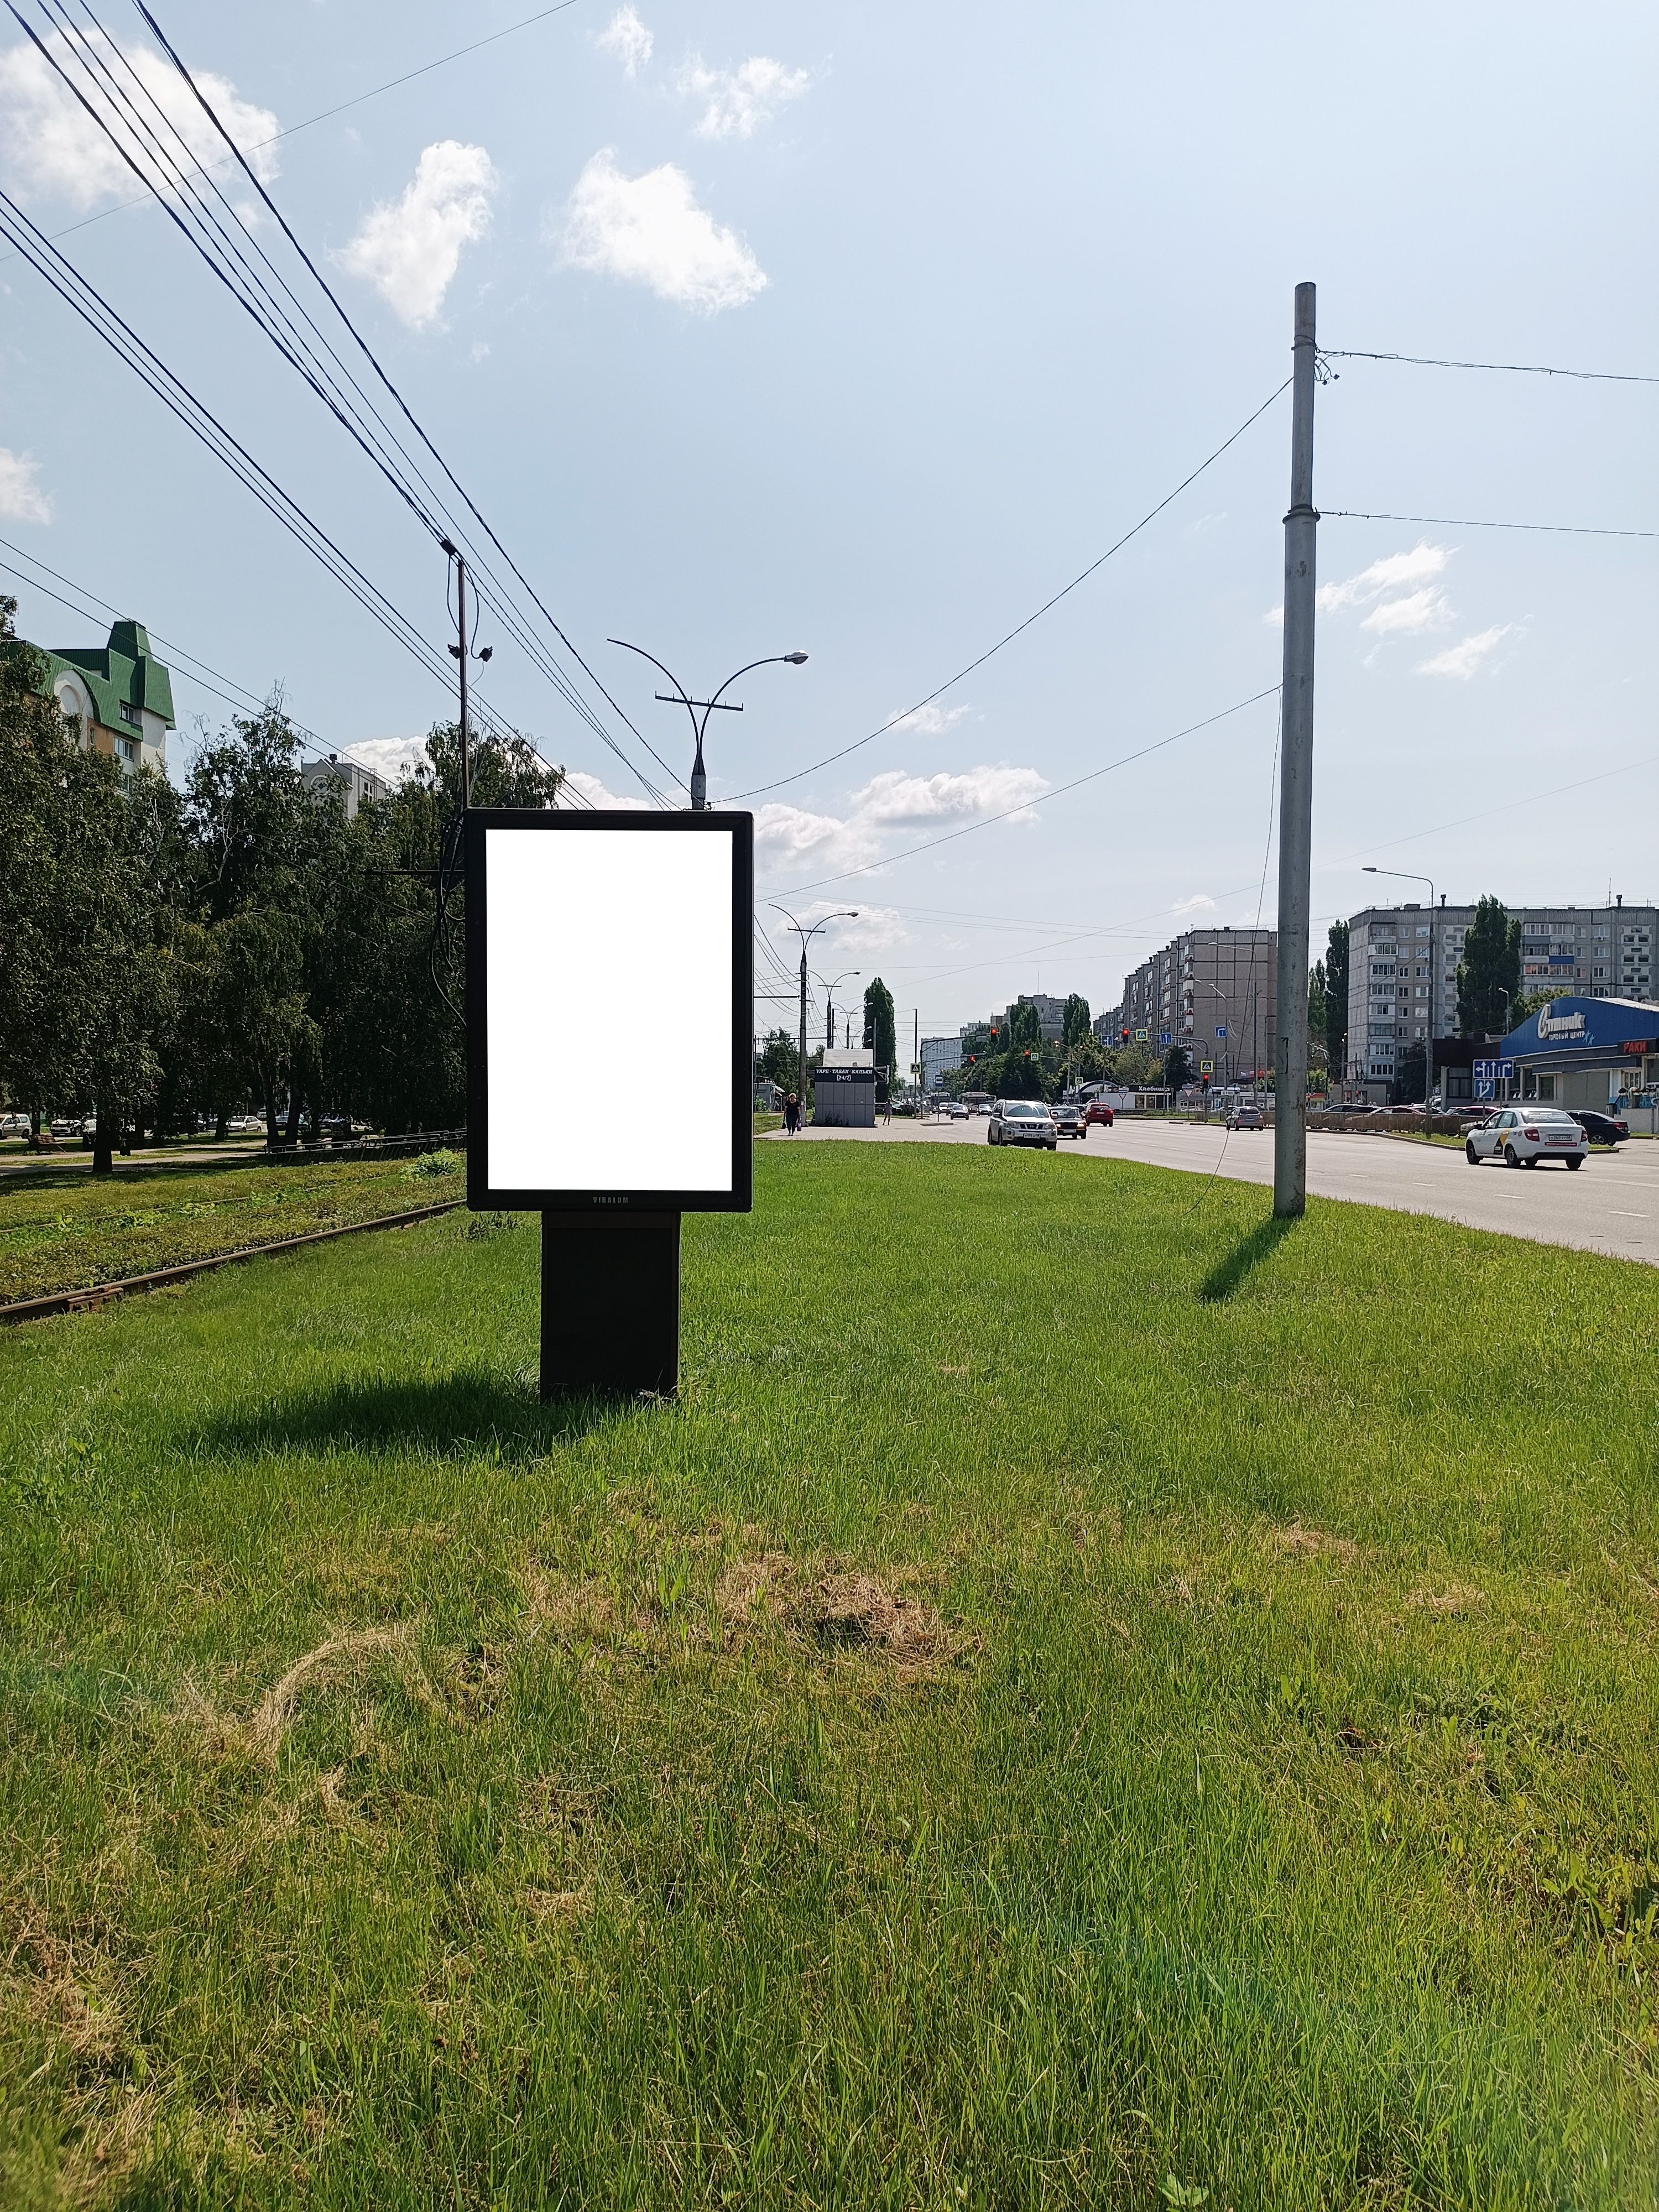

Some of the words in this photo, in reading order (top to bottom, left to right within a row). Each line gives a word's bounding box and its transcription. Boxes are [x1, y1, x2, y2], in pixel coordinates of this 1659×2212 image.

[1549, 1031, 1568, 1041] ТОРГОВЫЙ
[1570, 1031, 1585, 1040] ЦЕНТР
[1624, 1041, 1647, 1053] РАКИ
